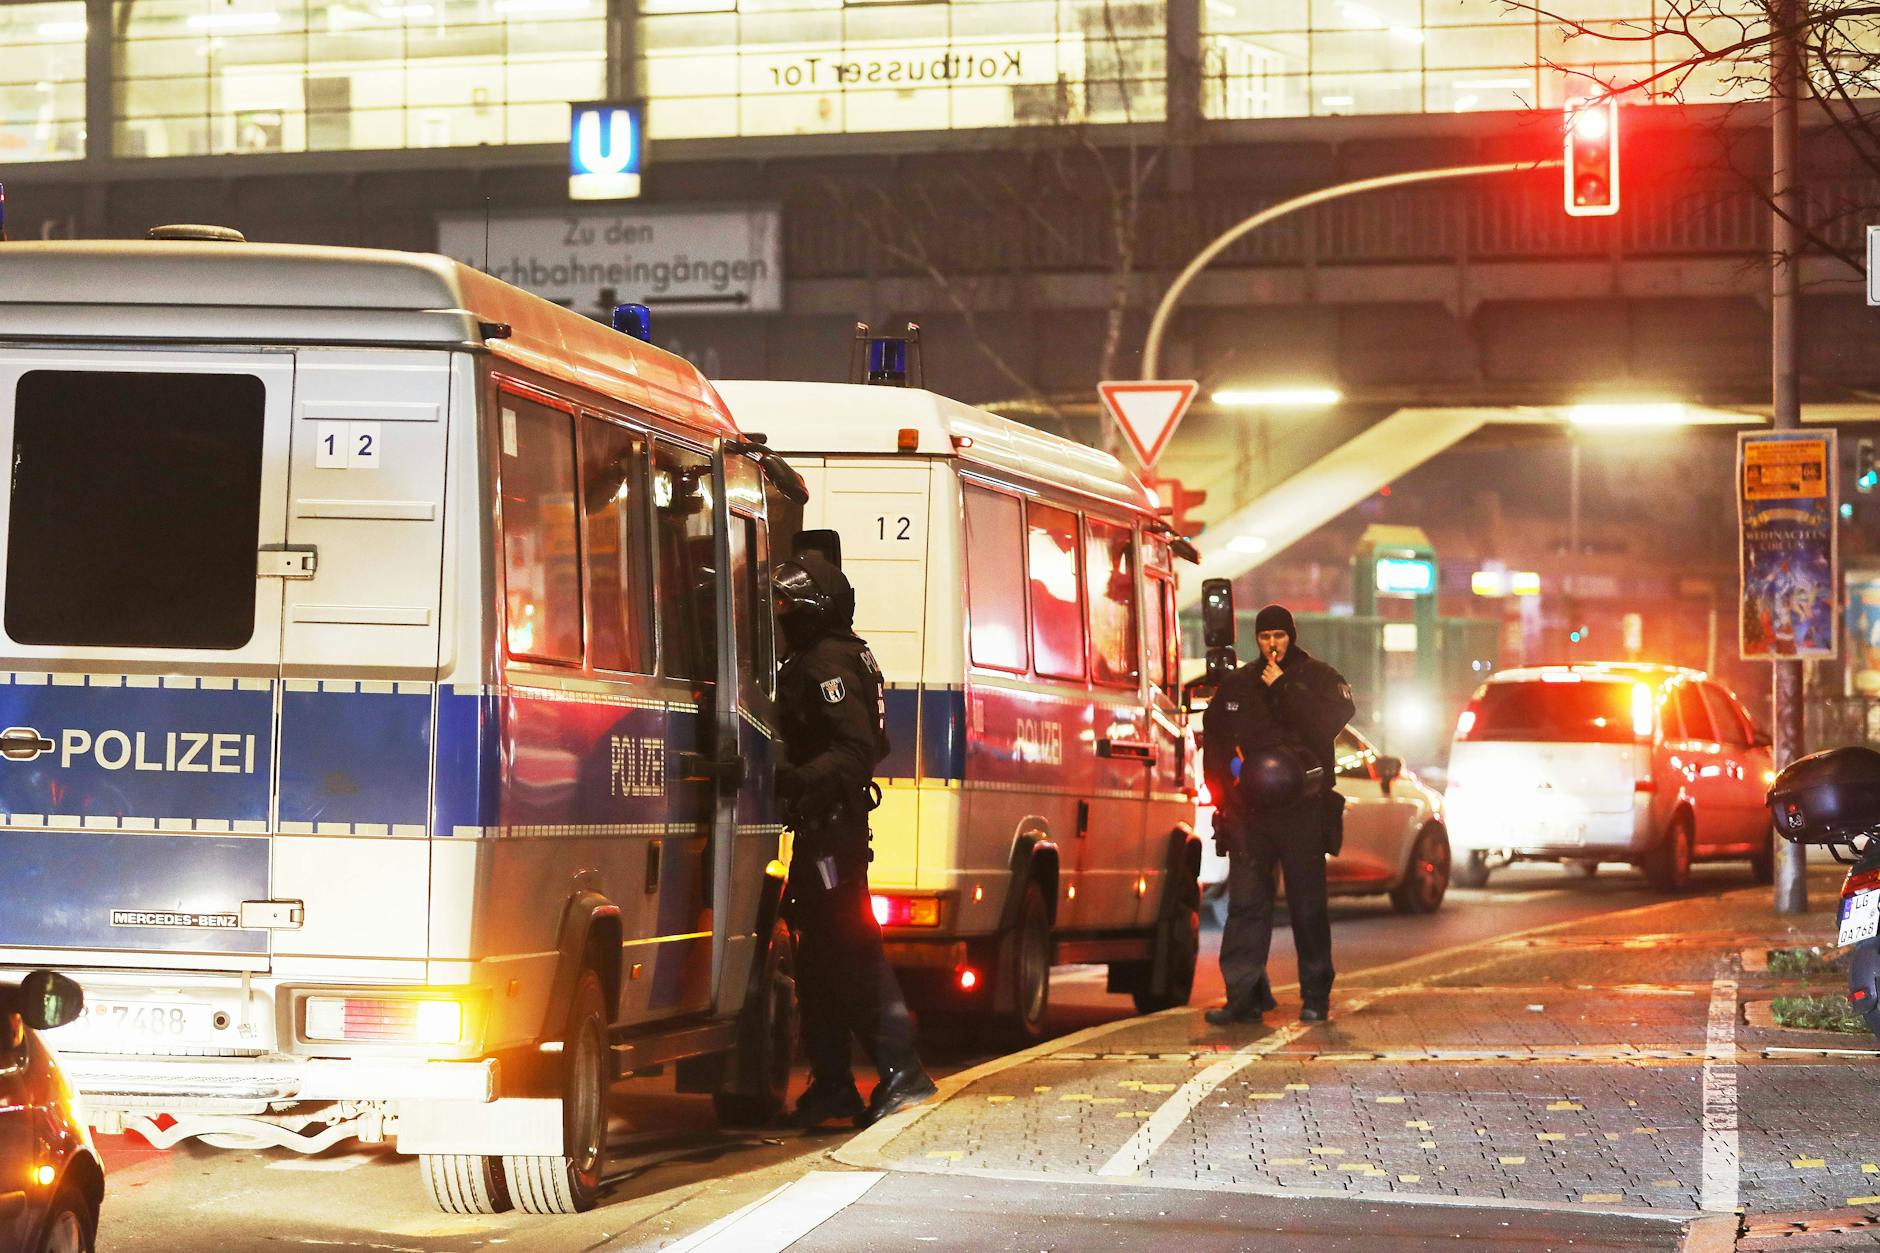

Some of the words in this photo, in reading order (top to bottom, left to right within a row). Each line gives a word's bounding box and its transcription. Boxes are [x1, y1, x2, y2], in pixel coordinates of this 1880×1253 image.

[579, 110, 631, 174] U
[562, 217, 595, 247] Zu
[603, 215, 654, 244] den
[464, 254, 767, 292] chbahneingängen
[61, 728, 256, 774] POLIZEI
[611, 735, 665, 797] POLIZEI
[1855, 894, 1869, 909] LG
[114, 911, 238, 928] MERCEDES-BENZ
[112, 1006, 184, 1035] 7488
